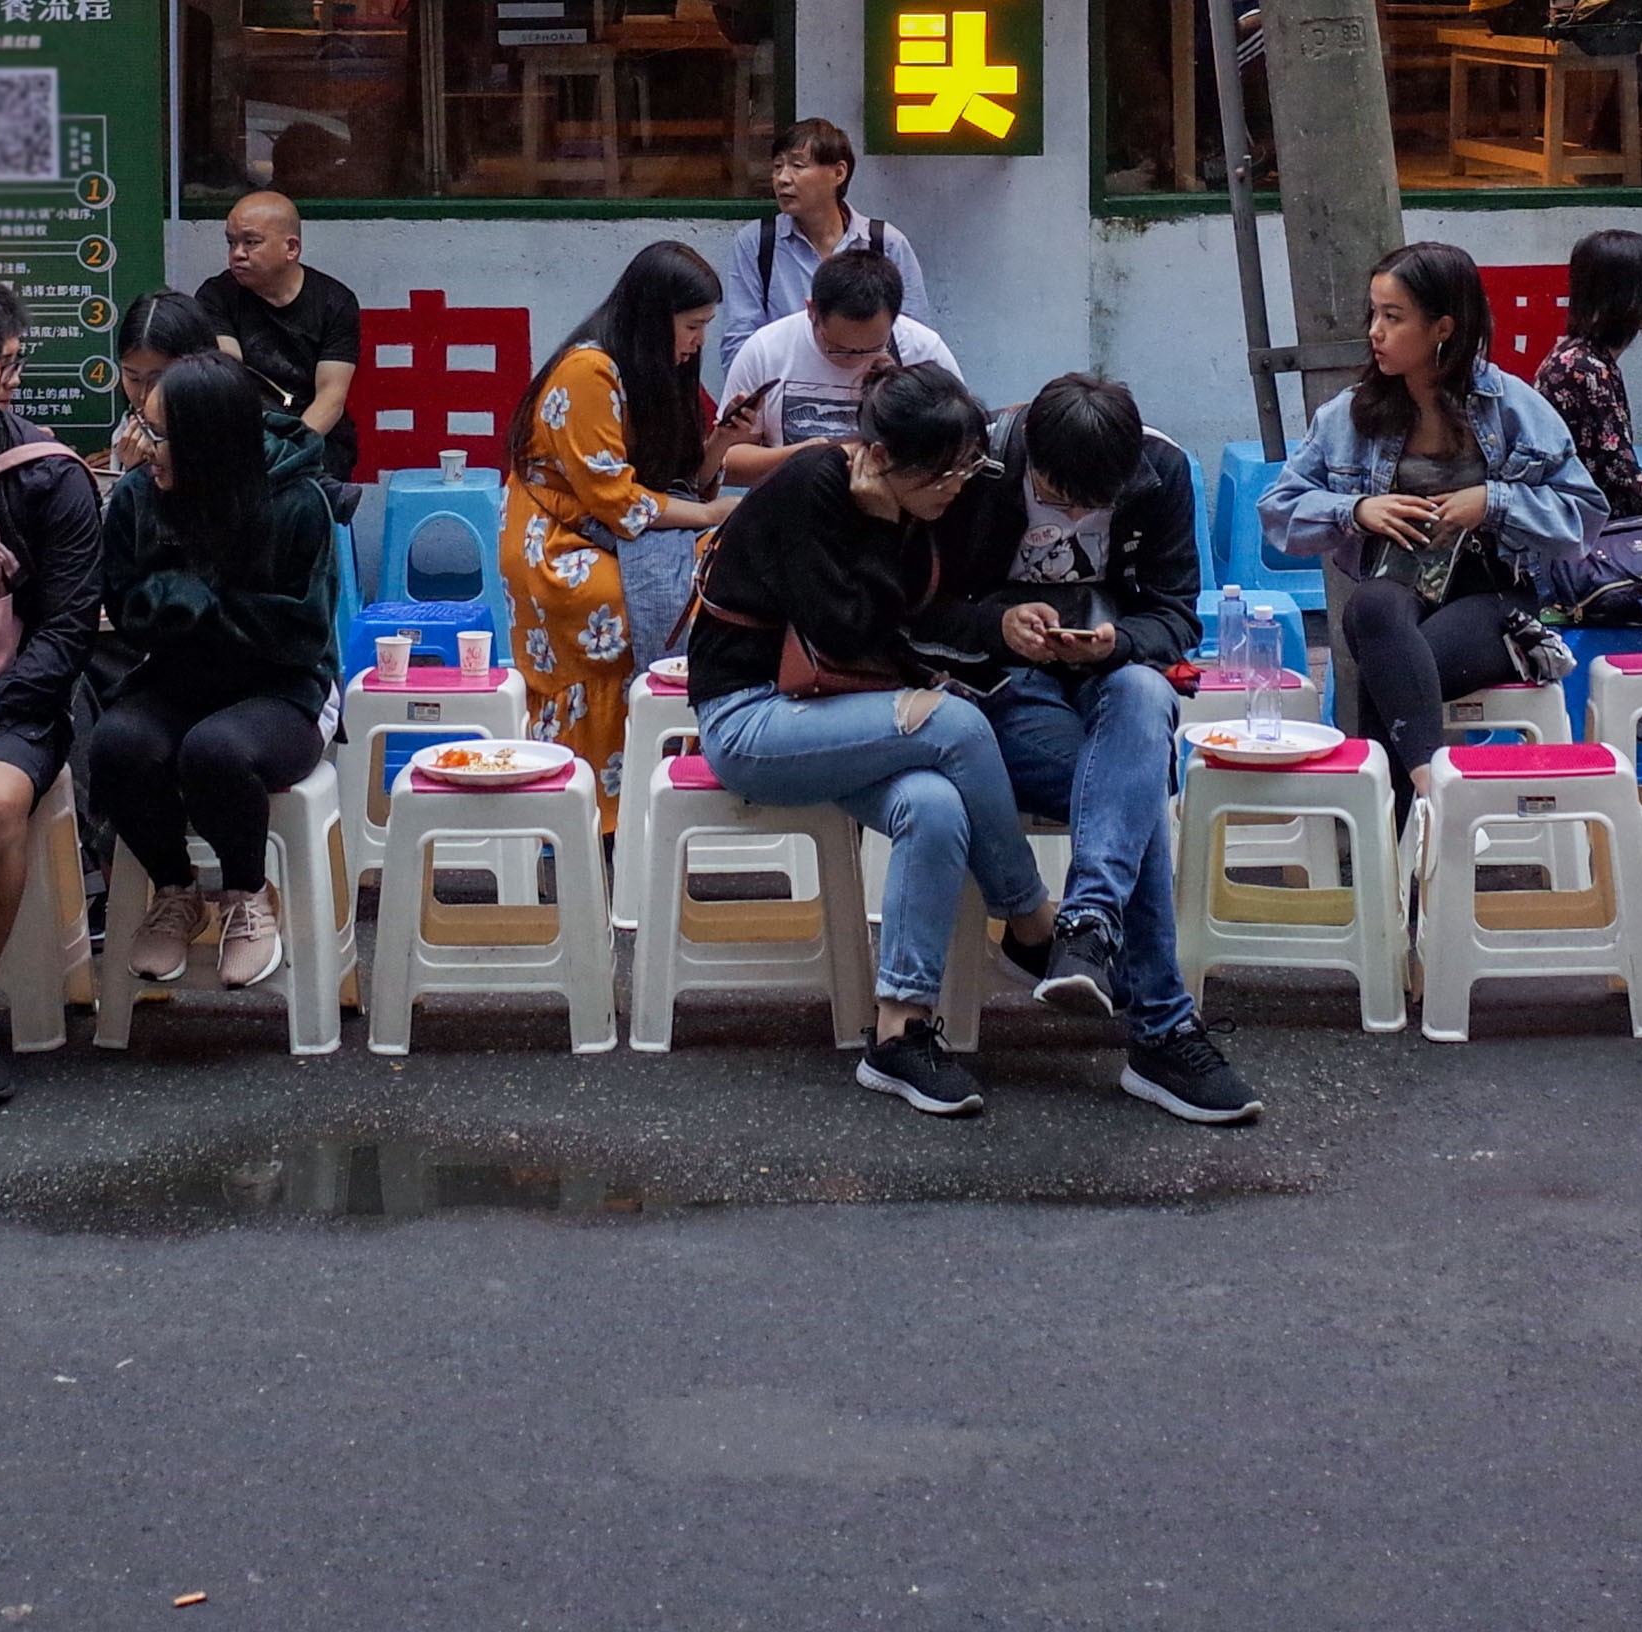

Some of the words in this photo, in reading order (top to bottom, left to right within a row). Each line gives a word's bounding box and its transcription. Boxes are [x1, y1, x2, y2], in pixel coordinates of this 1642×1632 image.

[86, 179, 101, 201] 1
[86, 241, 104, 264] 2
[22, 285, 92, 297] 选择立即使用
[87, 301, 105, 324] 3
[89, 361, 105, 383] 4
[9, 404, 73, 416] 可为您下单
